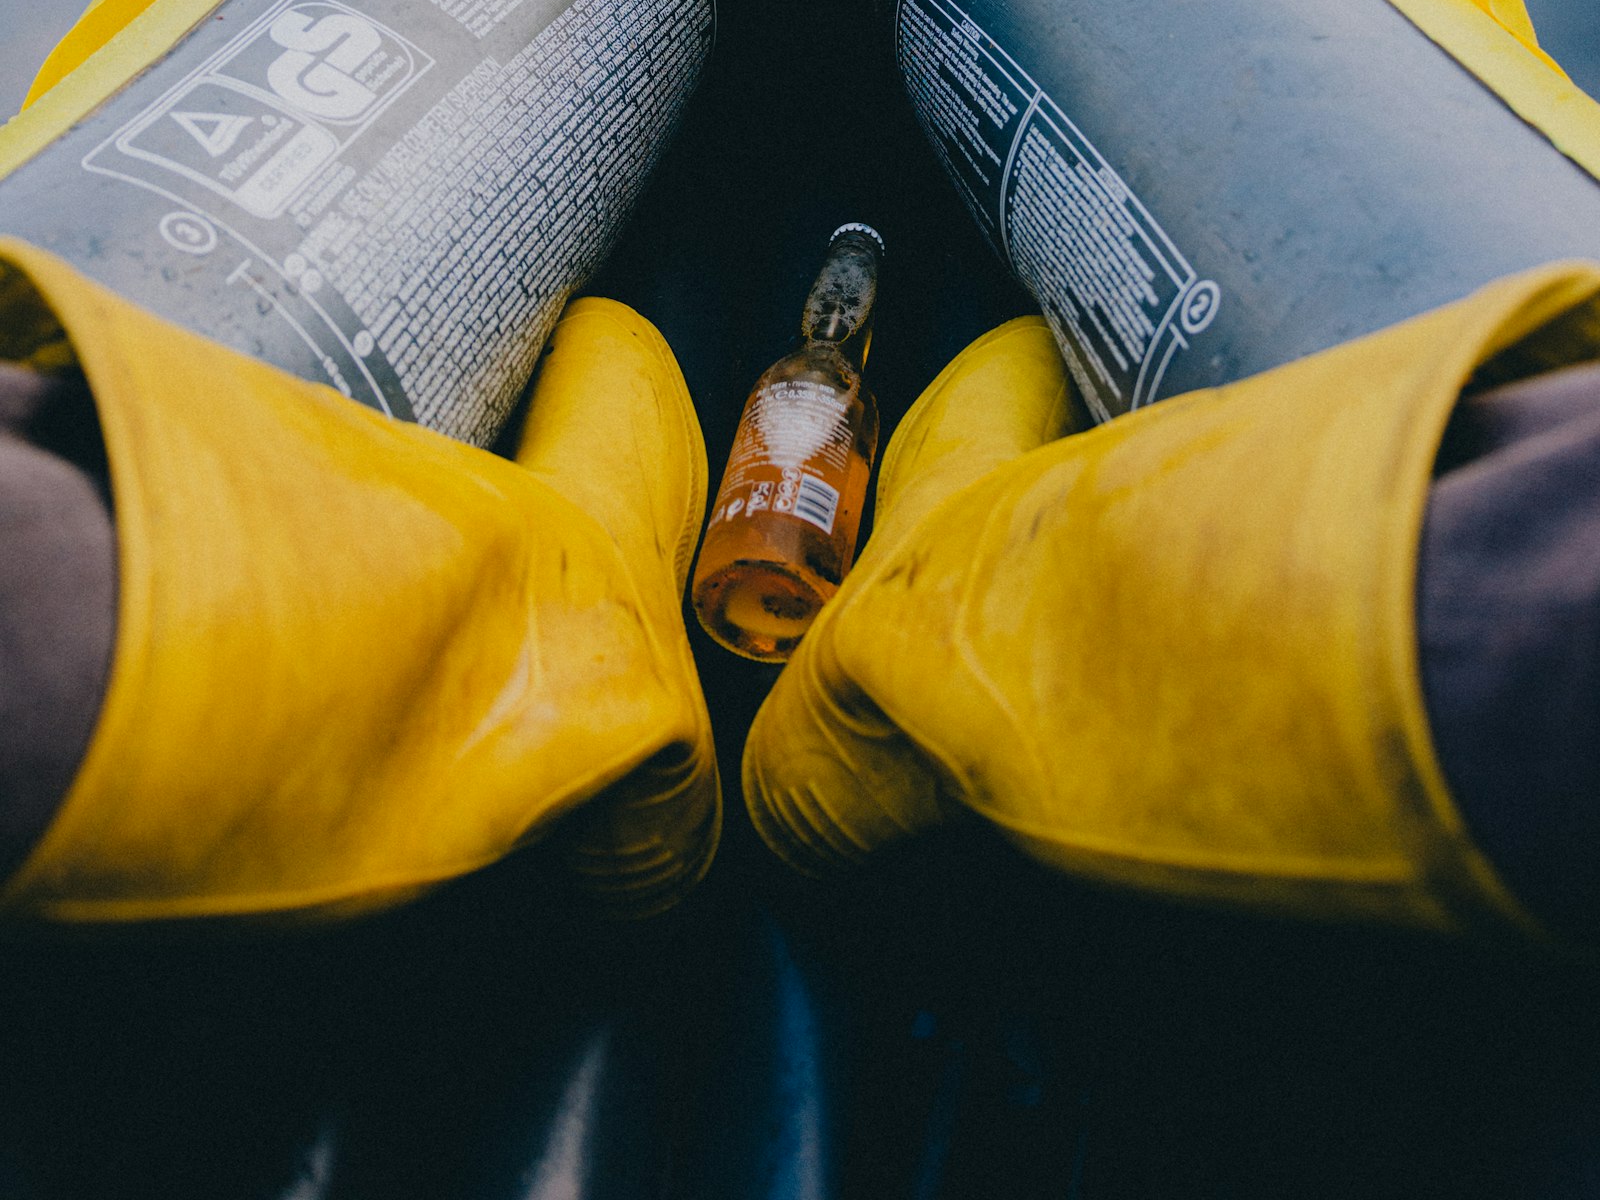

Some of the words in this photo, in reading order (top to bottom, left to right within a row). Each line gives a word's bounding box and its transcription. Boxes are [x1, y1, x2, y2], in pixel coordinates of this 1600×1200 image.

[534, 34, 562, 65] INFLUENCE
[558, 28, 569, 43] OF
[565, 10, 588, 37] ALCOHOL
[584, 4, 595, 19] OR
[535, 50, 563, 79] FLOTATION
[559, 35, 579, 58] DEVICE
[586, 20, 595, 33] IS
[591, 1, 615, 28] REQUIRED
[536, 23, 556, 47] DEVICE
[552, 19, 561, 32] IS
[579, 48, 597, 70] NEVER
[593, 37, 609, 56] WRAP
[605, 24, 622, 45] ROPES
[619, 9, 639, 32] AROUND
[635, 0, 649, 15] HEAD
[620, 33, 630, 47] OR
[626, 20, 643, 41] OTHER
[638, 5, 657, 27] SERIOUS
[949, 26, 964, 44] Safety
[961, 38, 979, 60] Warning
[960, 18, 981, 42] CAUTION
[445, 53, 502, 109] SUPERVISION
[549, 53, 576, 83] OFFSHORE
[587, 28, 603, 47] OPEN
[572, 91, 586, 107] PAY
[581, 67, 609, 98] ATTENTION
[606, 60, 615, 73] TO
[625, 38, 638, 54] AND
[592, 74, 619, 105] ATTENTION
[638, 44, 647, 57] ET
[643, 37, 654, 51] AUX
[573, 115, 596, 142] CUIDADO
[592, 104, 606, 121] CON
[620, 81, 627, 91] Y
[175, 222, 201, 242] 3
[1190, 293, 1209, 320] 2
